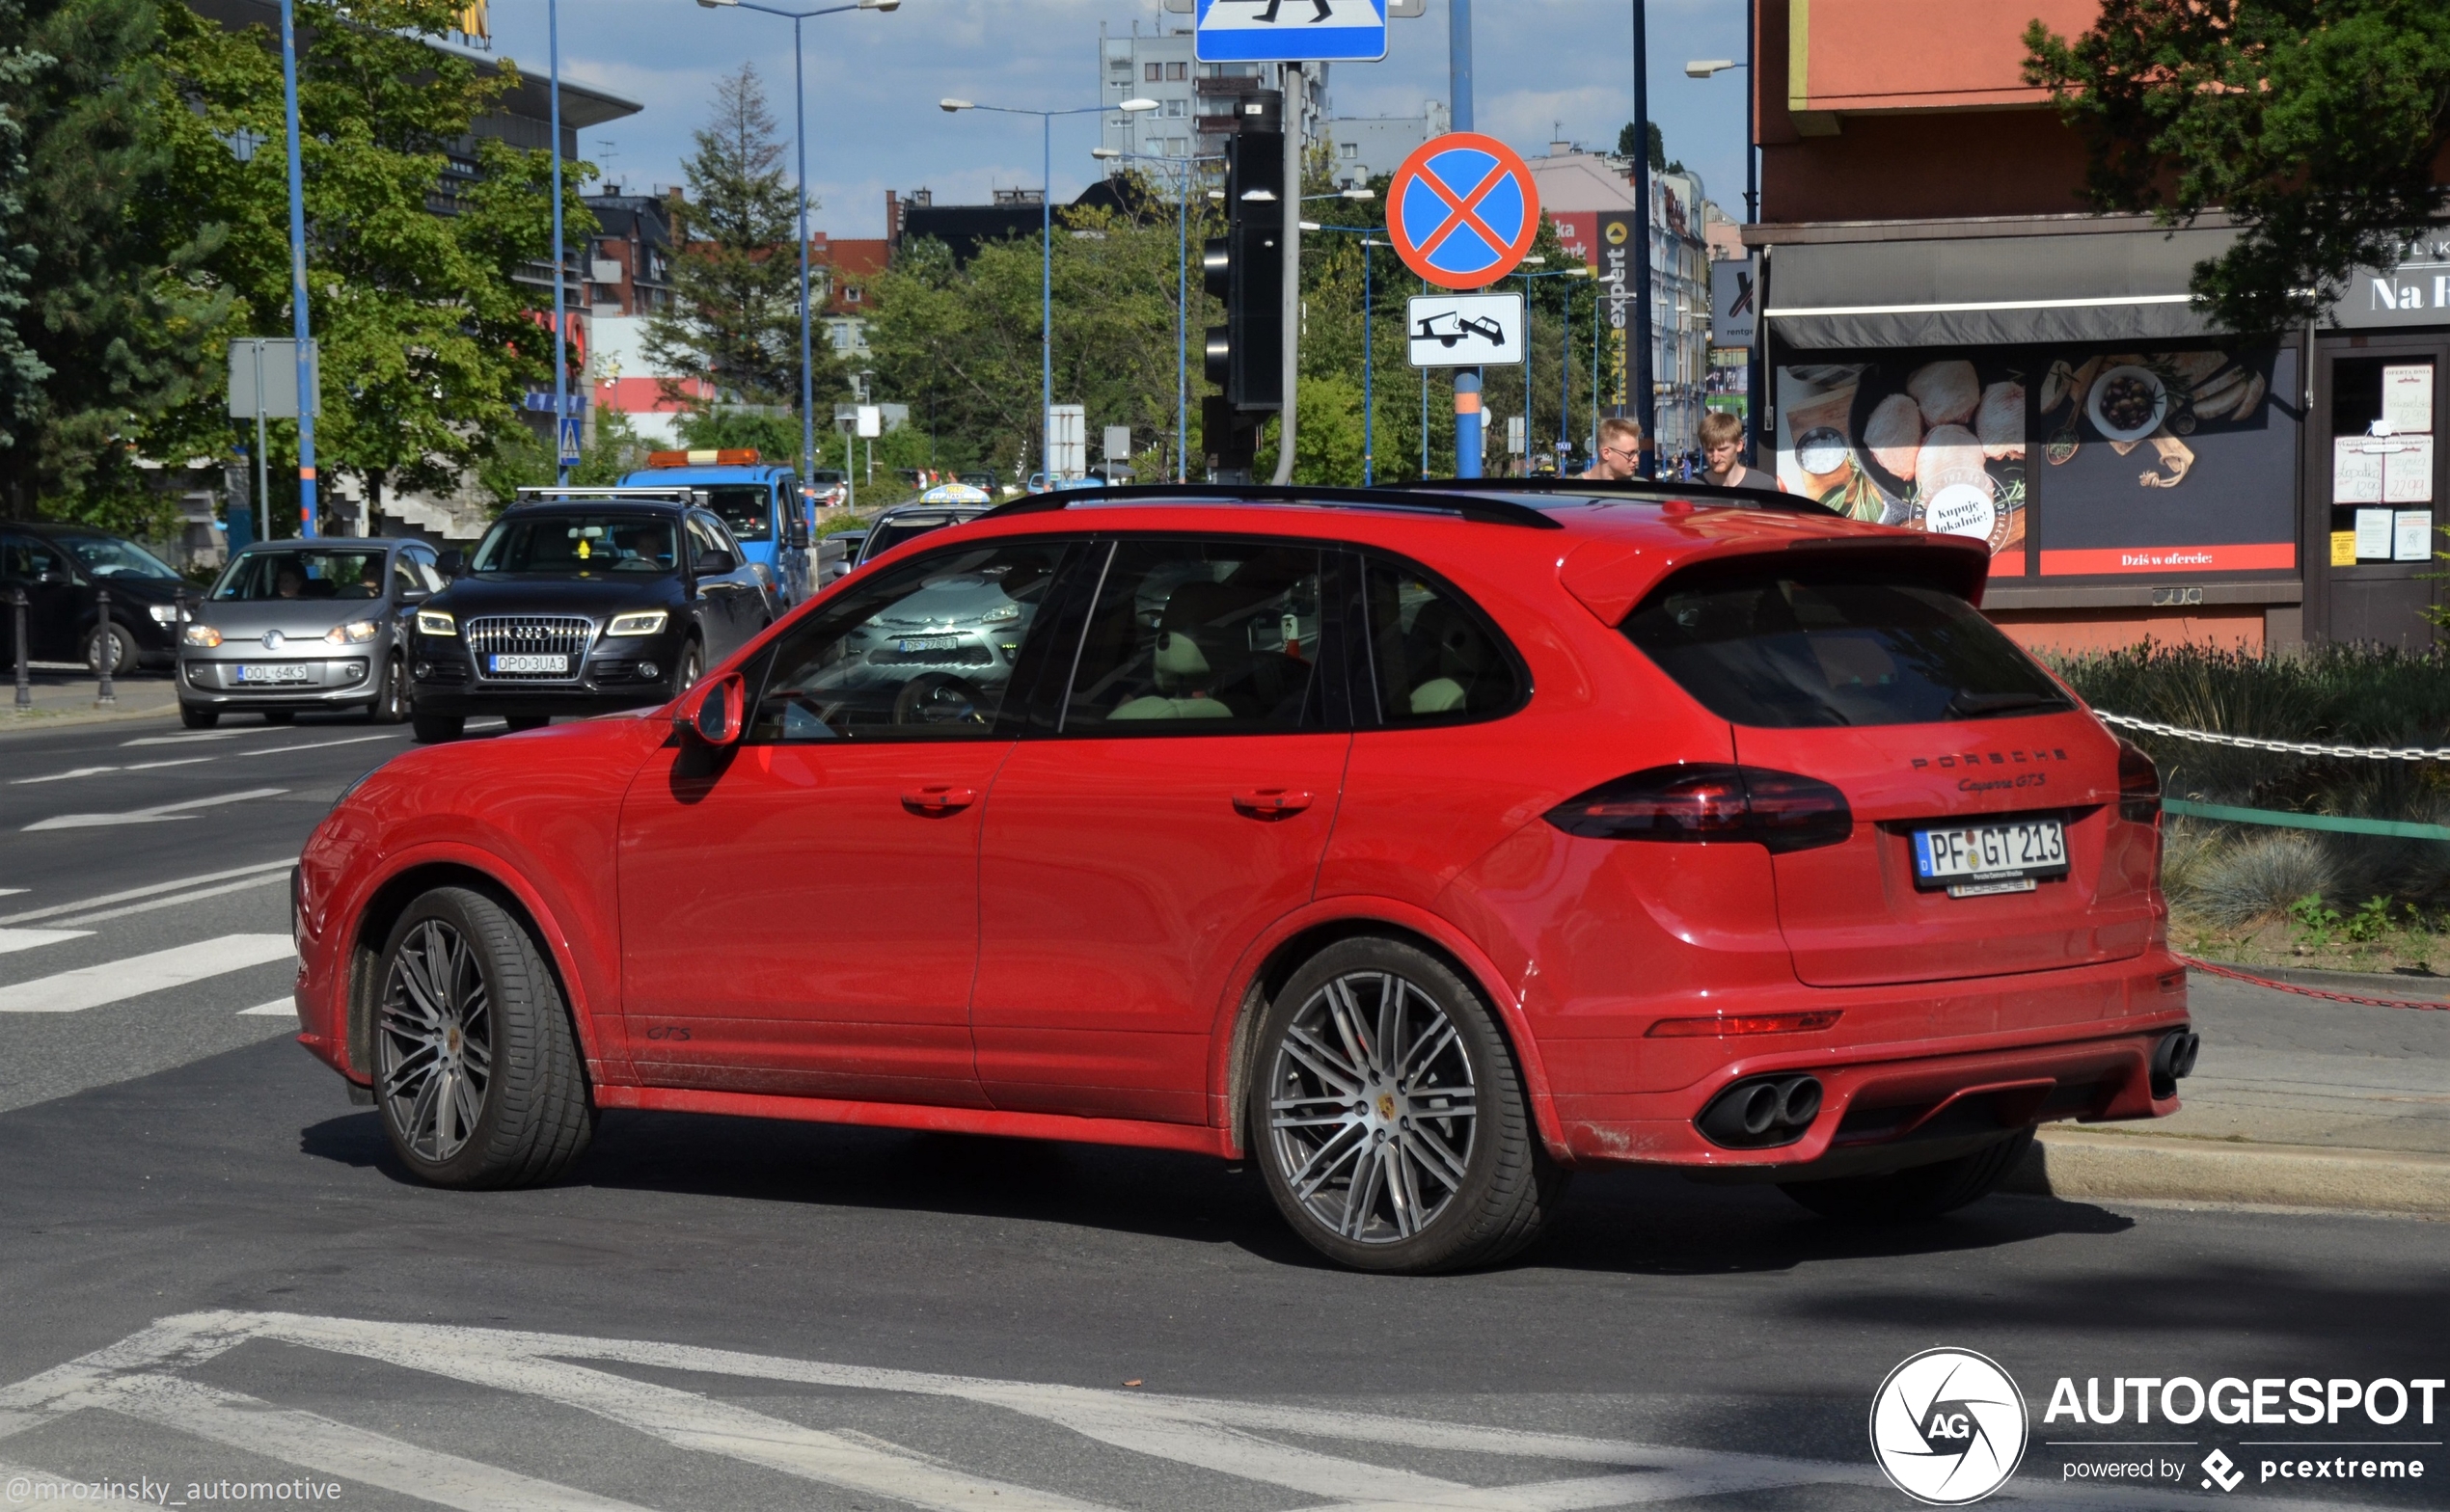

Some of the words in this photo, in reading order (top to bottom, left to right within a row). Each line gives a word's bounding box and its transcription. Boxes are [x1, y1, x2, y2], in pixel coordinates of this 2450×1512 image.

[1555, 220, 1575, 238] ka
[2371, 278, 2425, 310] Na
[1937, 500, 1979, 520] Kupuję
[1935, 511, 1988, 533] lokalnie!
[1989, 503, 2007, 550] DZIAŁAM
[2122, 554, 2149, 566] Dziś
[2164, 553, 2213, 564] ofercie:
[499, 657, 528, 670] OPO
[531, 657, 566, 670] 3UA3
[1911, 748, 2069, 770] PORSCHE
[1958, 777, 2013, 796] Cayenne
[2015, 772, 2047, 788] GTS
[1930, 831, 1964, 871] PF
[1981, 826, 2011, 866] GT
[2018, 823, 2062, 864] 213
[1921, 860, 1929, 872] D
[1964, 881, 2026, 893] PORSCHE
[646, 1026, 692, 1041] GTS
